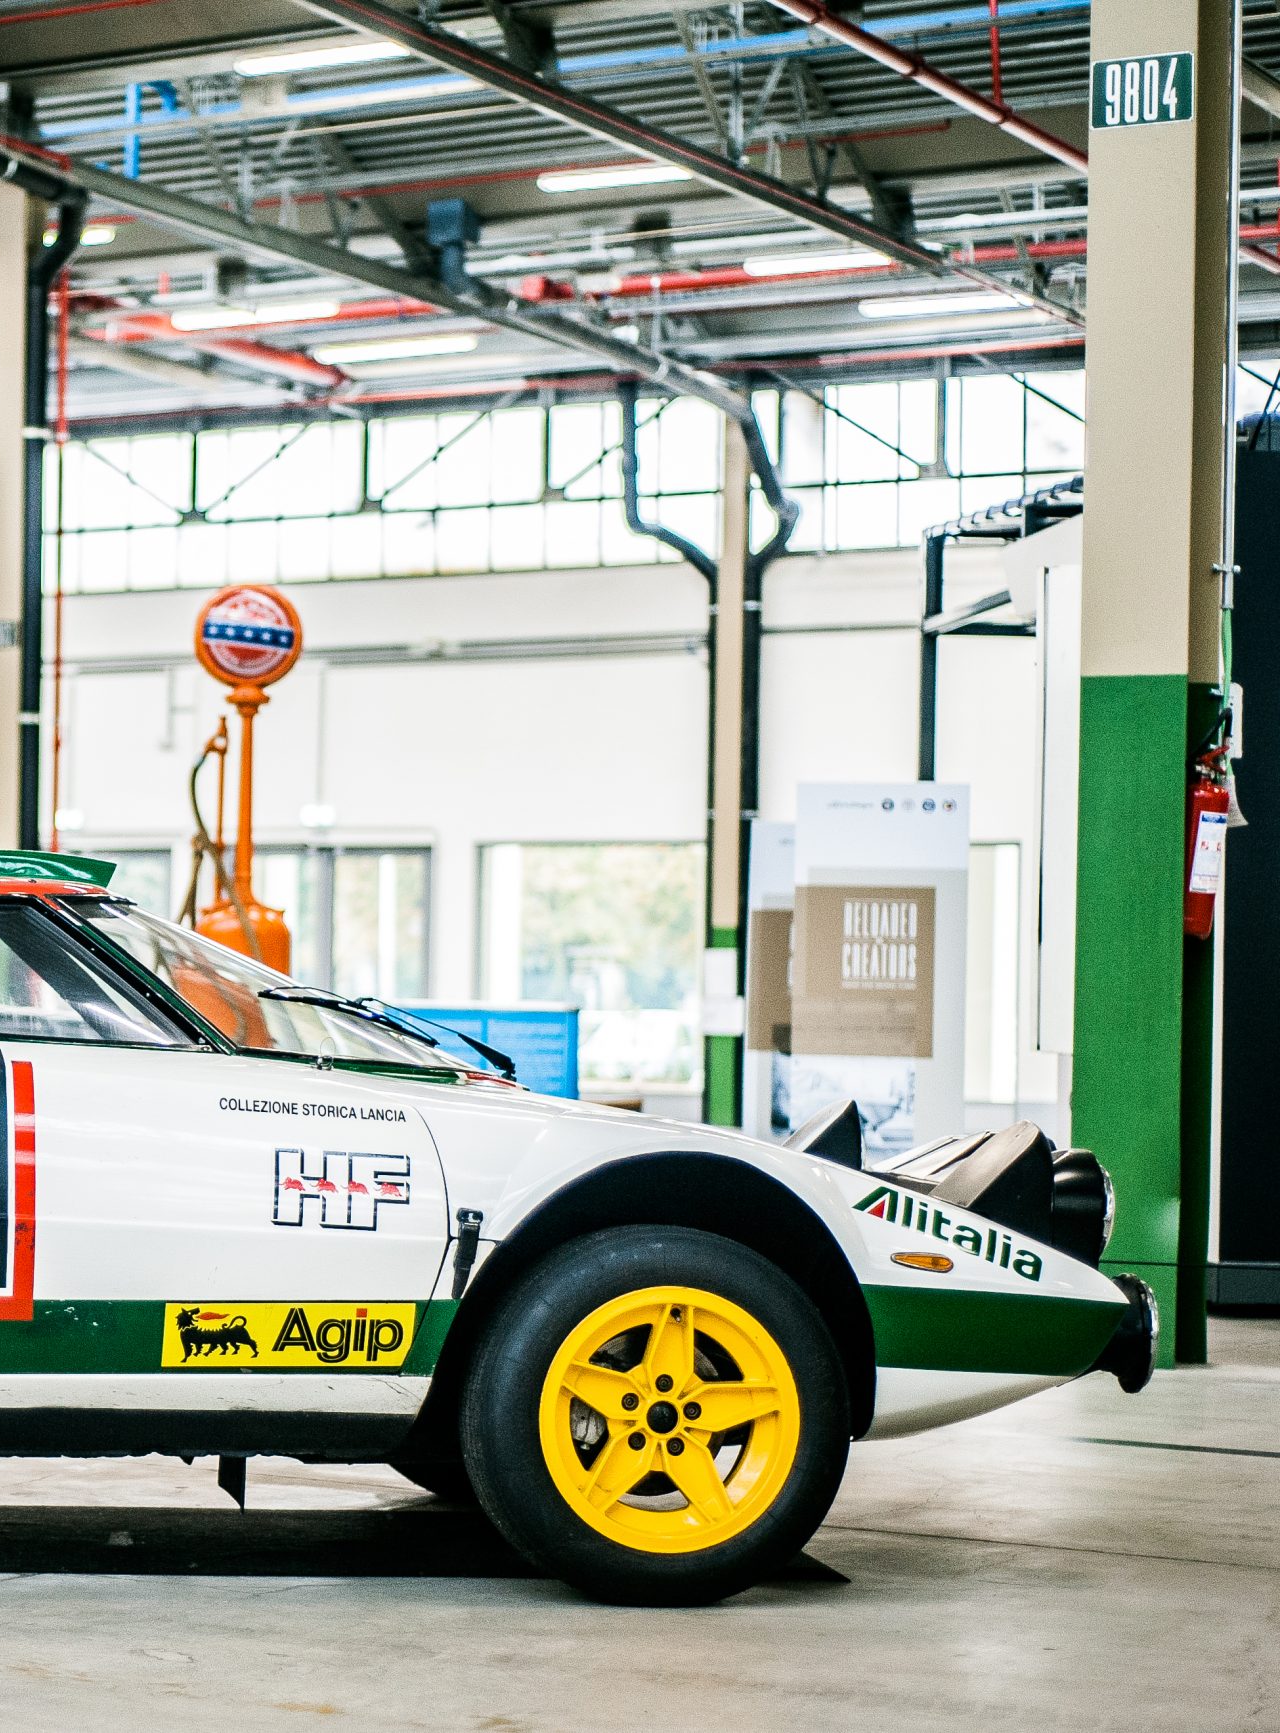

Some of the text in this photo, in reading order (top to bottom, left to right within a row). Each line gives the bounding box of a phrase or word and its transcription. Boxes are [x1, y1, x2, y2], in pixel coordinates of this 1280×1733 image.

[1105, 57, 1178, 125] 9804
[219, 1097, 407, 1122] COLLEZIONE STORICA LANCIA
[271, 1148, 410, 1231] HF
[852, 1186, 1043, 1282] Alitalia
[271, 1307, 404, 1363] Agip
